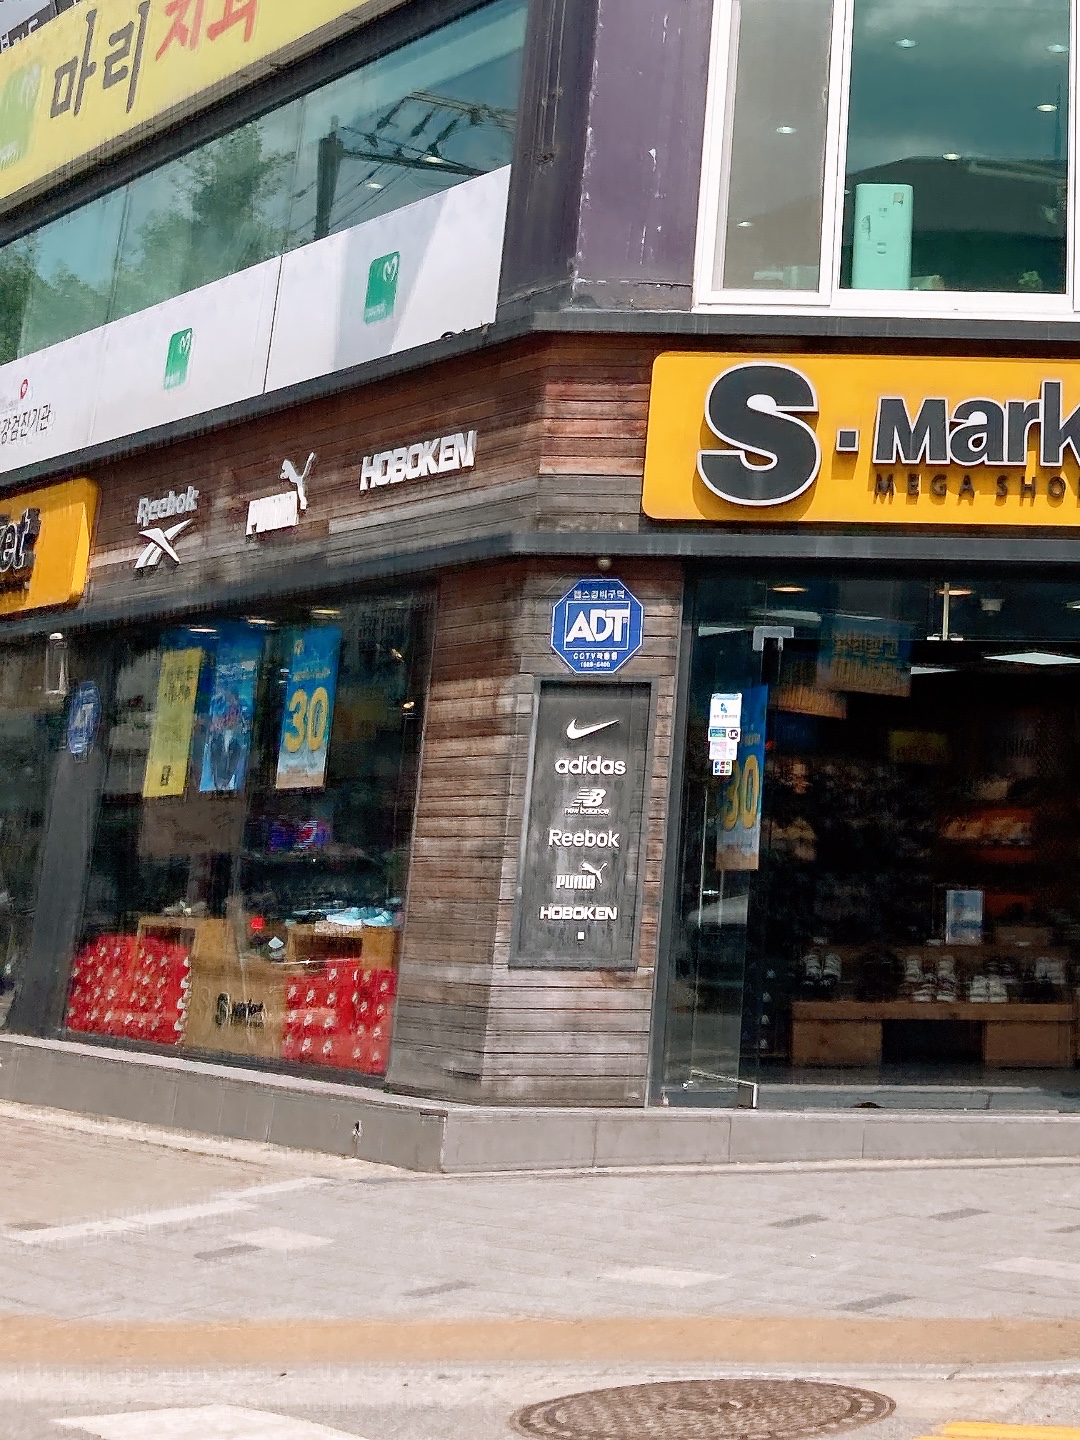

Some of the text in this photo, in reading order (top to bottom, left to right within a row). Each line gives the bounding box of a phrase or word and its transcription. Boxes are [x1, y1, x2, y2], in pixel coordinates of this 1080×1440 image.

[359, 430, 477, 491] HOBOKEN
[874, 473, 975, 500] MEGA
[137, 486, 199, 526] Reebok
[566, 609, 629, 642] ADT
[285, 687, 328, 753] 30
[554, 756, 626, 776] adidas
[548, 829, 620, 849] Reebok
[555, 875, 596, 890] PUMA
[539, 906, 618, 921] HOBOKEN
